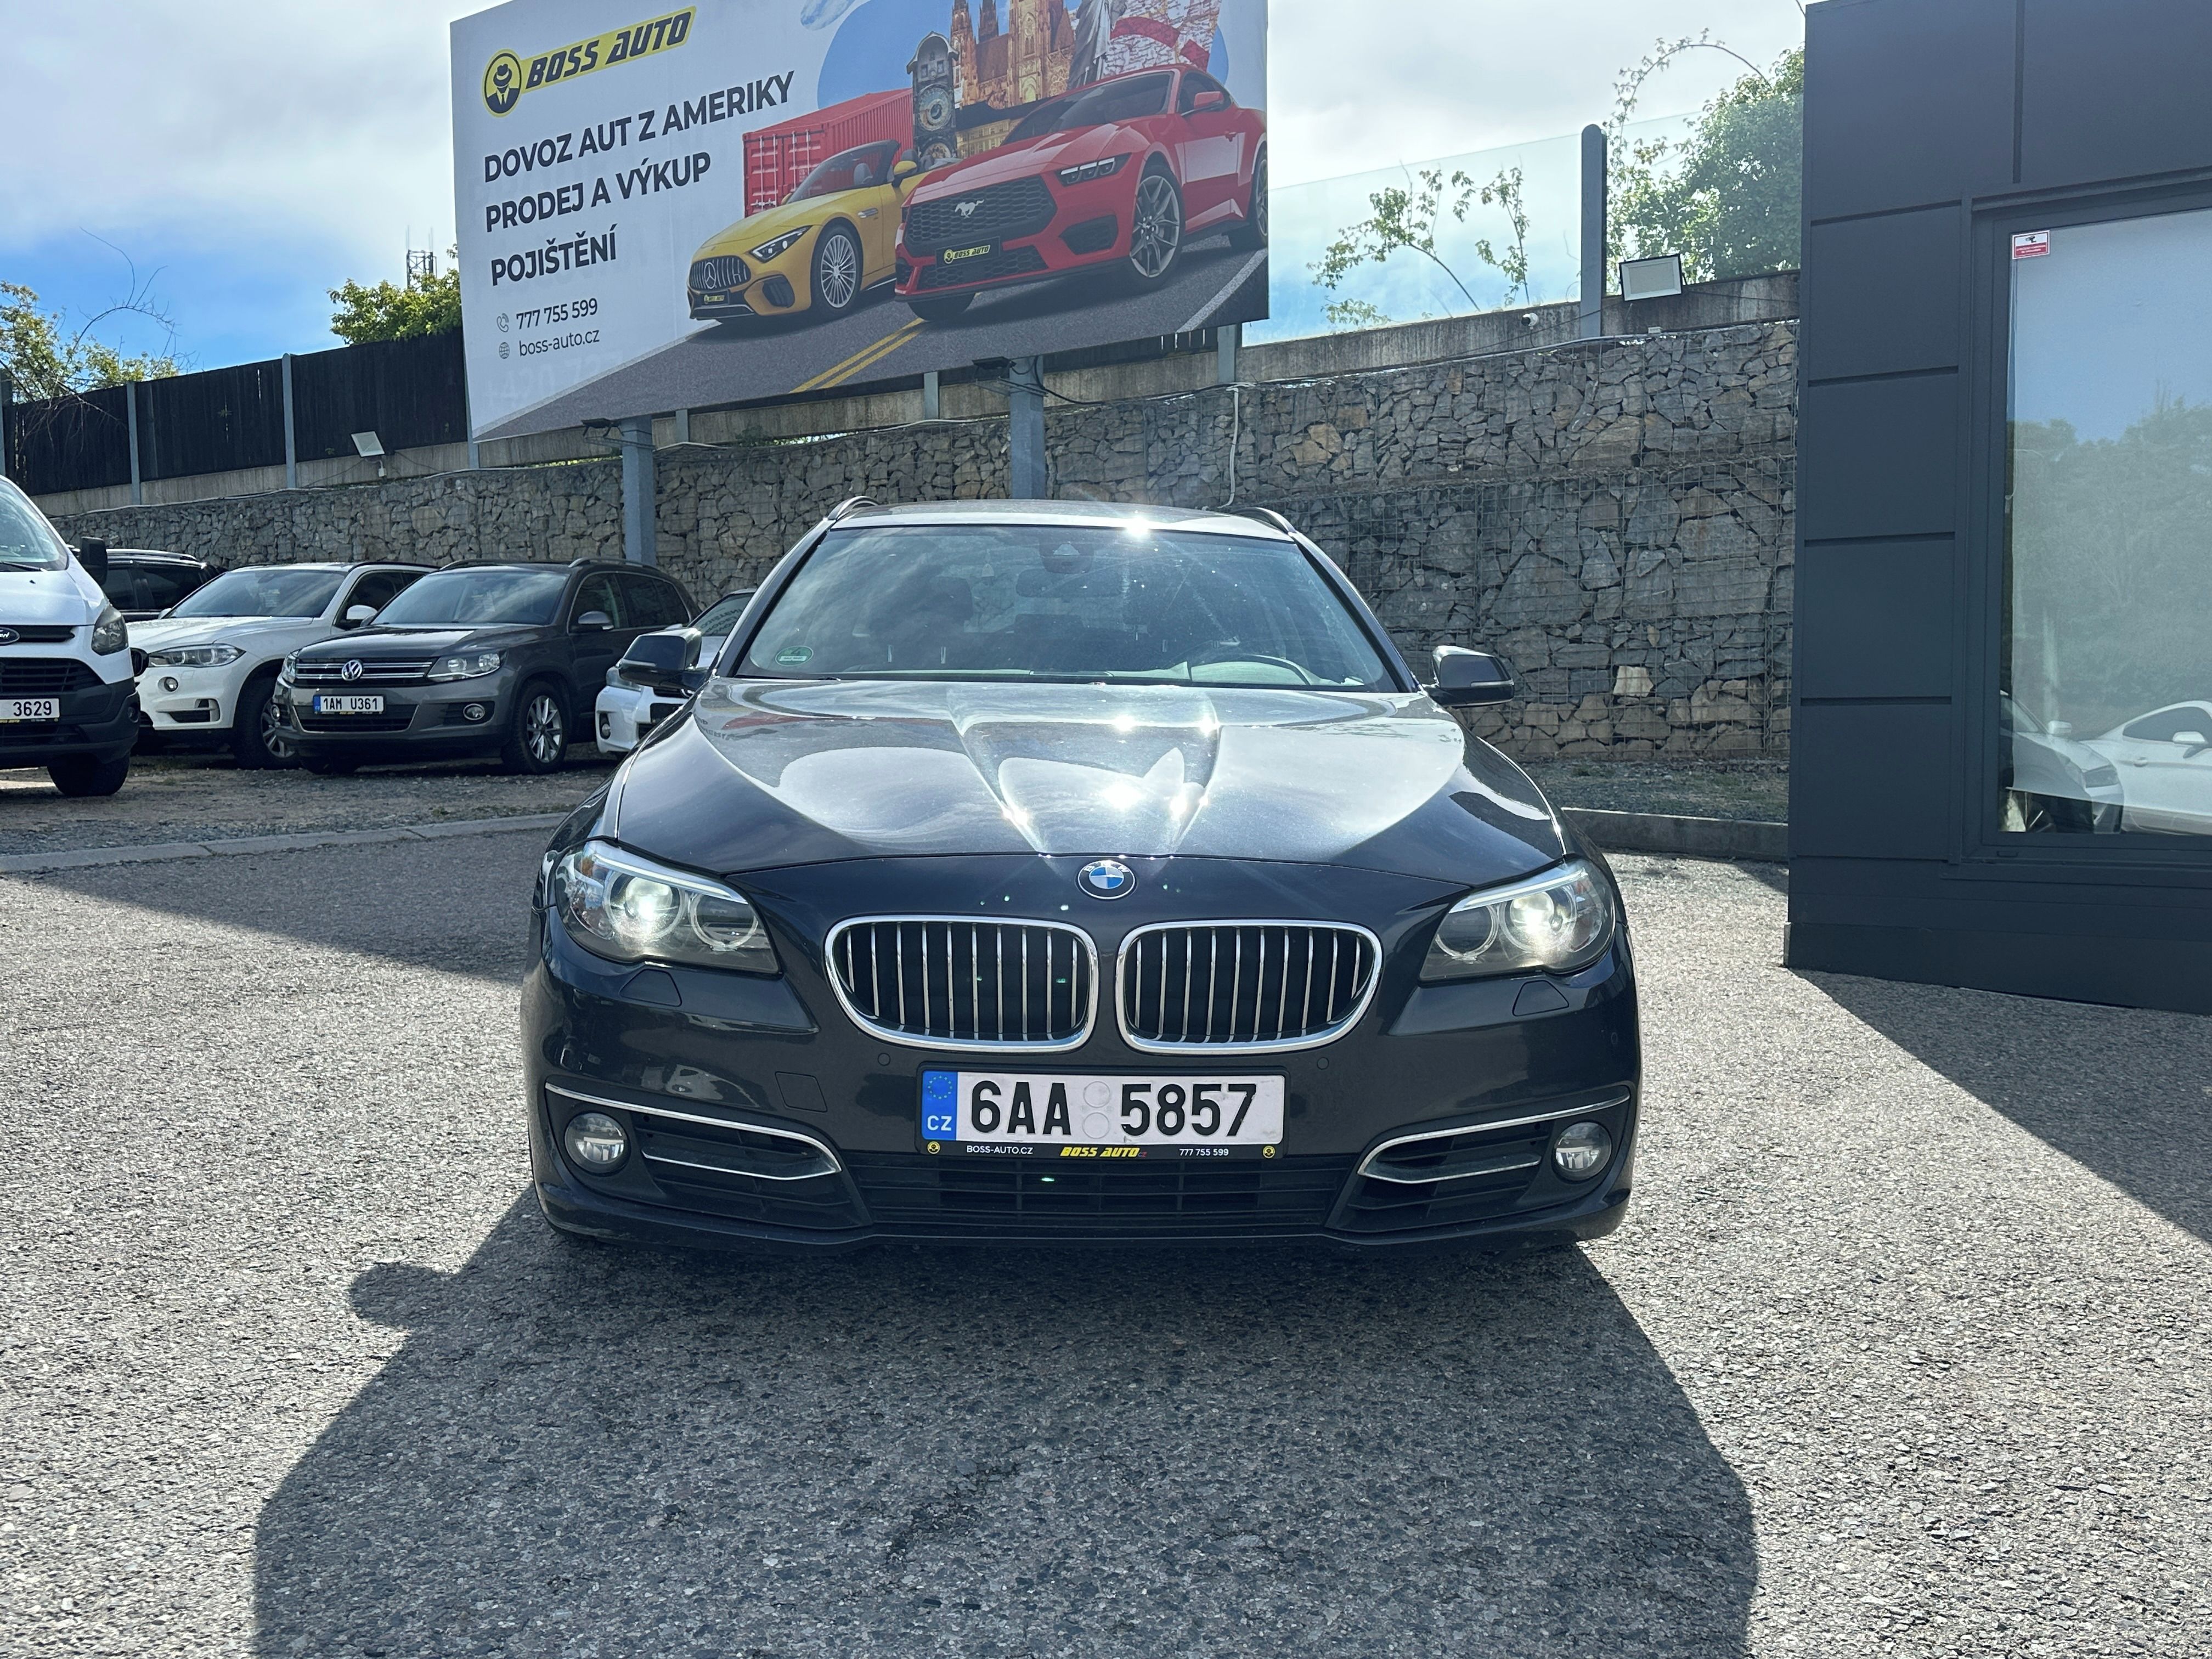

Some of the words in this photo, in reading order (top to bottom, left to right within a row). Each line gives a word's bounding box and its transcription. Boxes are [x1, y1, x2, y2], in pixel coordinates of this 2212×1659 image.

[526, 40, 599, 89] BOSS
[605, 12, 691, 65] AUTO
[484, 133, 572, 183] DOVOZ
[578, 116, 631, 157] AUT
[639, 110, 656, 142] Z
[662, 71, 794, 136] AMERIKY
[486, 183, 583, 232] PRODEJ
[591, 178, 611, 207] A
[616, 153, 710, 199] VÝKUP
[492, 224, 617, 286] POJIŠTĚNÍ
[955, 250, 970, 258] BOSS
[972, 246, 989, 255] AUTO
[516, 309, 540, 329] 777
[544, 304, 568, 324] 755
[572, 298, 597, 318] 599
[520, 330, 599, 356] boss-auto.cz
[13, 701, 52, 716] 3629
[324, 698, 342, 710] 1AM
[351, 698, 377, 710] U361
[972, 1081, 1071, 1135] 6AA
[1121, 1084, 1256, 1136] 5857
[928, 1115, 951, 1131] CZ
[967, 1146, 1033, 1154] BOSS-AUTO.CZ
[1060, 1147, 1098, 1157] BOSS
[1100, 1147, 1140, 1157] AUTO
